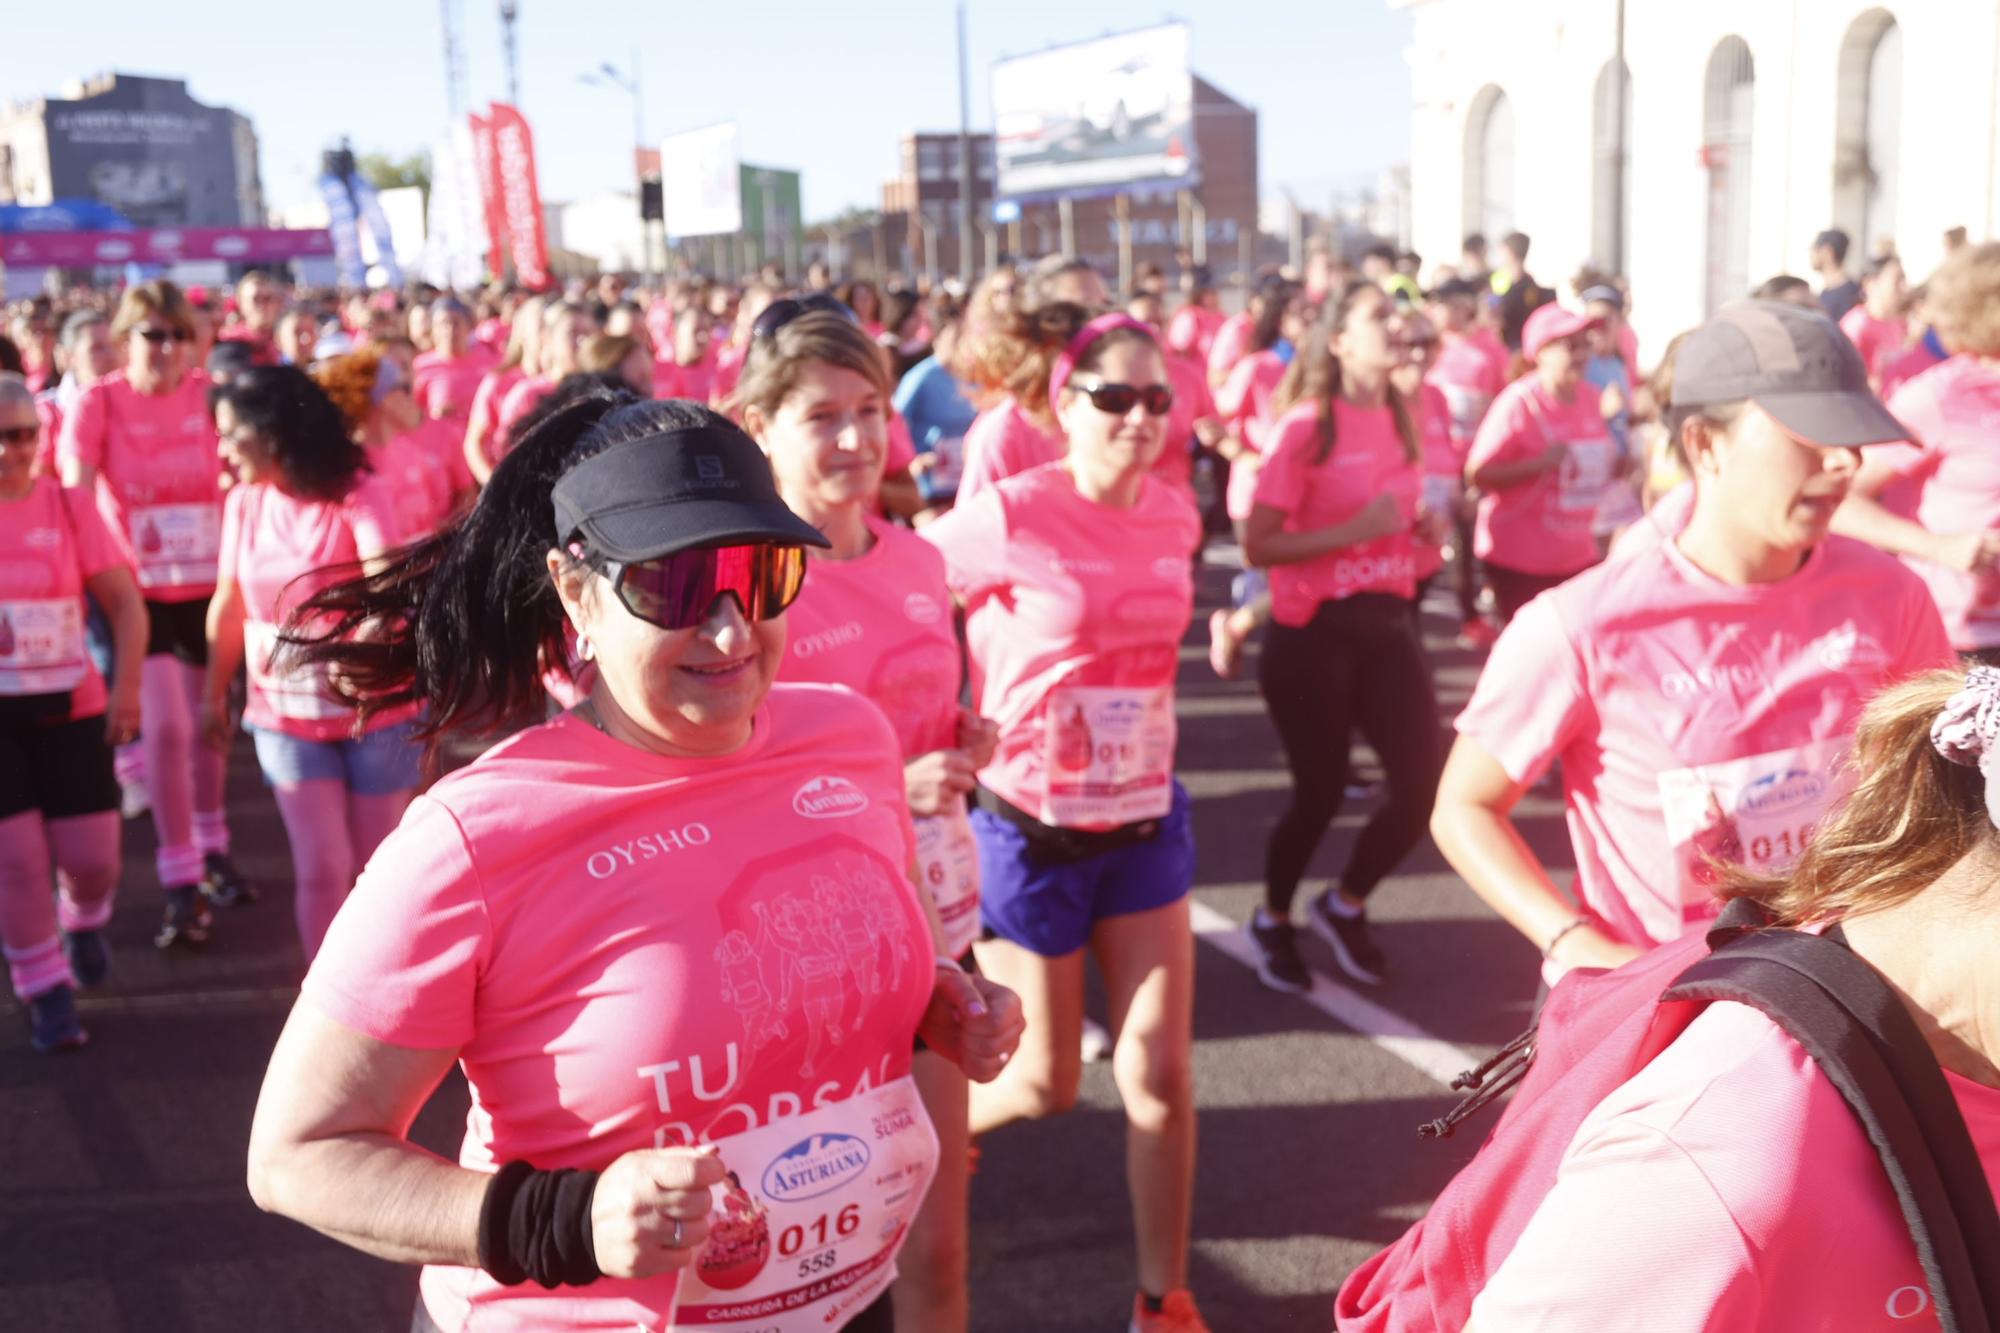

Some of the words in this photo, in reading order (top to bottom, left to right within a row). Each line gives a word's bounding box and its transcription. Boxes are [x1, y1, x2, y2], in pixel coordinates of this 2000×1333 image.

[586, 822, 711, 879] OYSHO
[636, 1042, 738, 1114] TU
[773, 1151, 864, 1194] ASTURIANA
[778, 1203, 860, 1256] 016
[797, 1249, 836, 1278] 558
[706, 1296, 783, 1321] CARRERA
[786, 1290, 806, 1307] DE
[808, 1281, 829, 1299] LA
